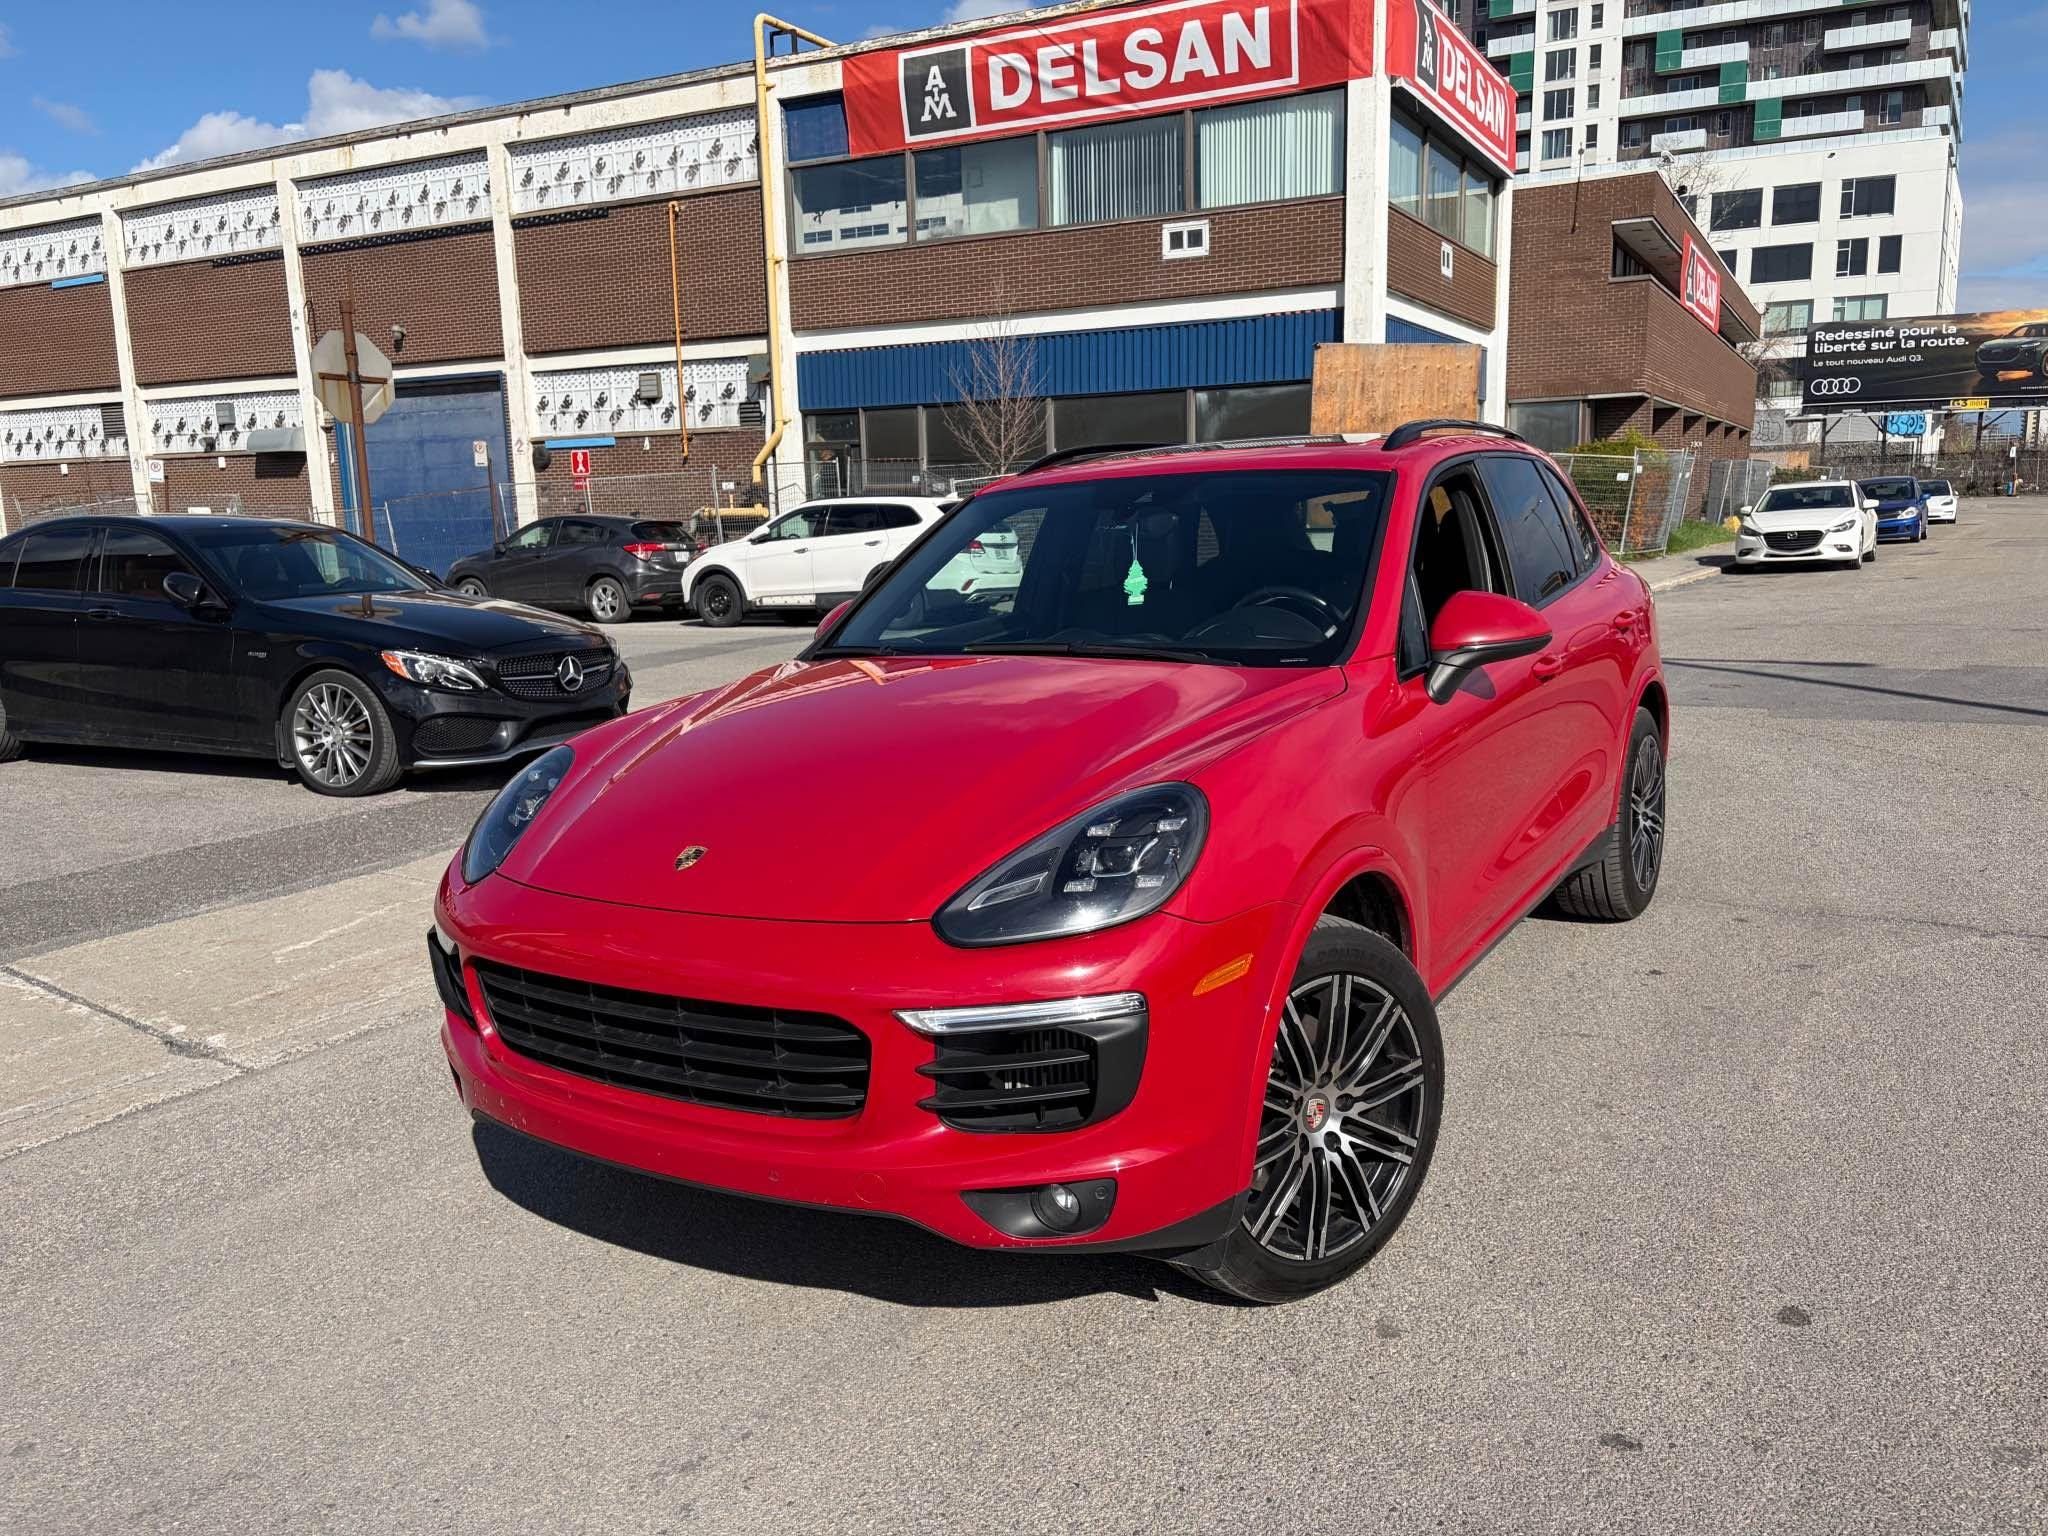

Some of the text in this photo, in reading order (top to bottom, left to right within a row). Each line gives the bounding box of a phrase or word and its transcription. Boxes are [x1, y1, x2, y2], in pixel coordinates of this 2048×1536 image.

[988, 6, 1271, 111] DELSAN
[1441, 32, 1506, 141] DELSAN
[1815, 324, 1957, 342] Redessiné pour la
[1814, 336, 1970, 354] liberté sur la route.
[1813, 354, 1924, 368] Le tout nouveau Audi Q3.
